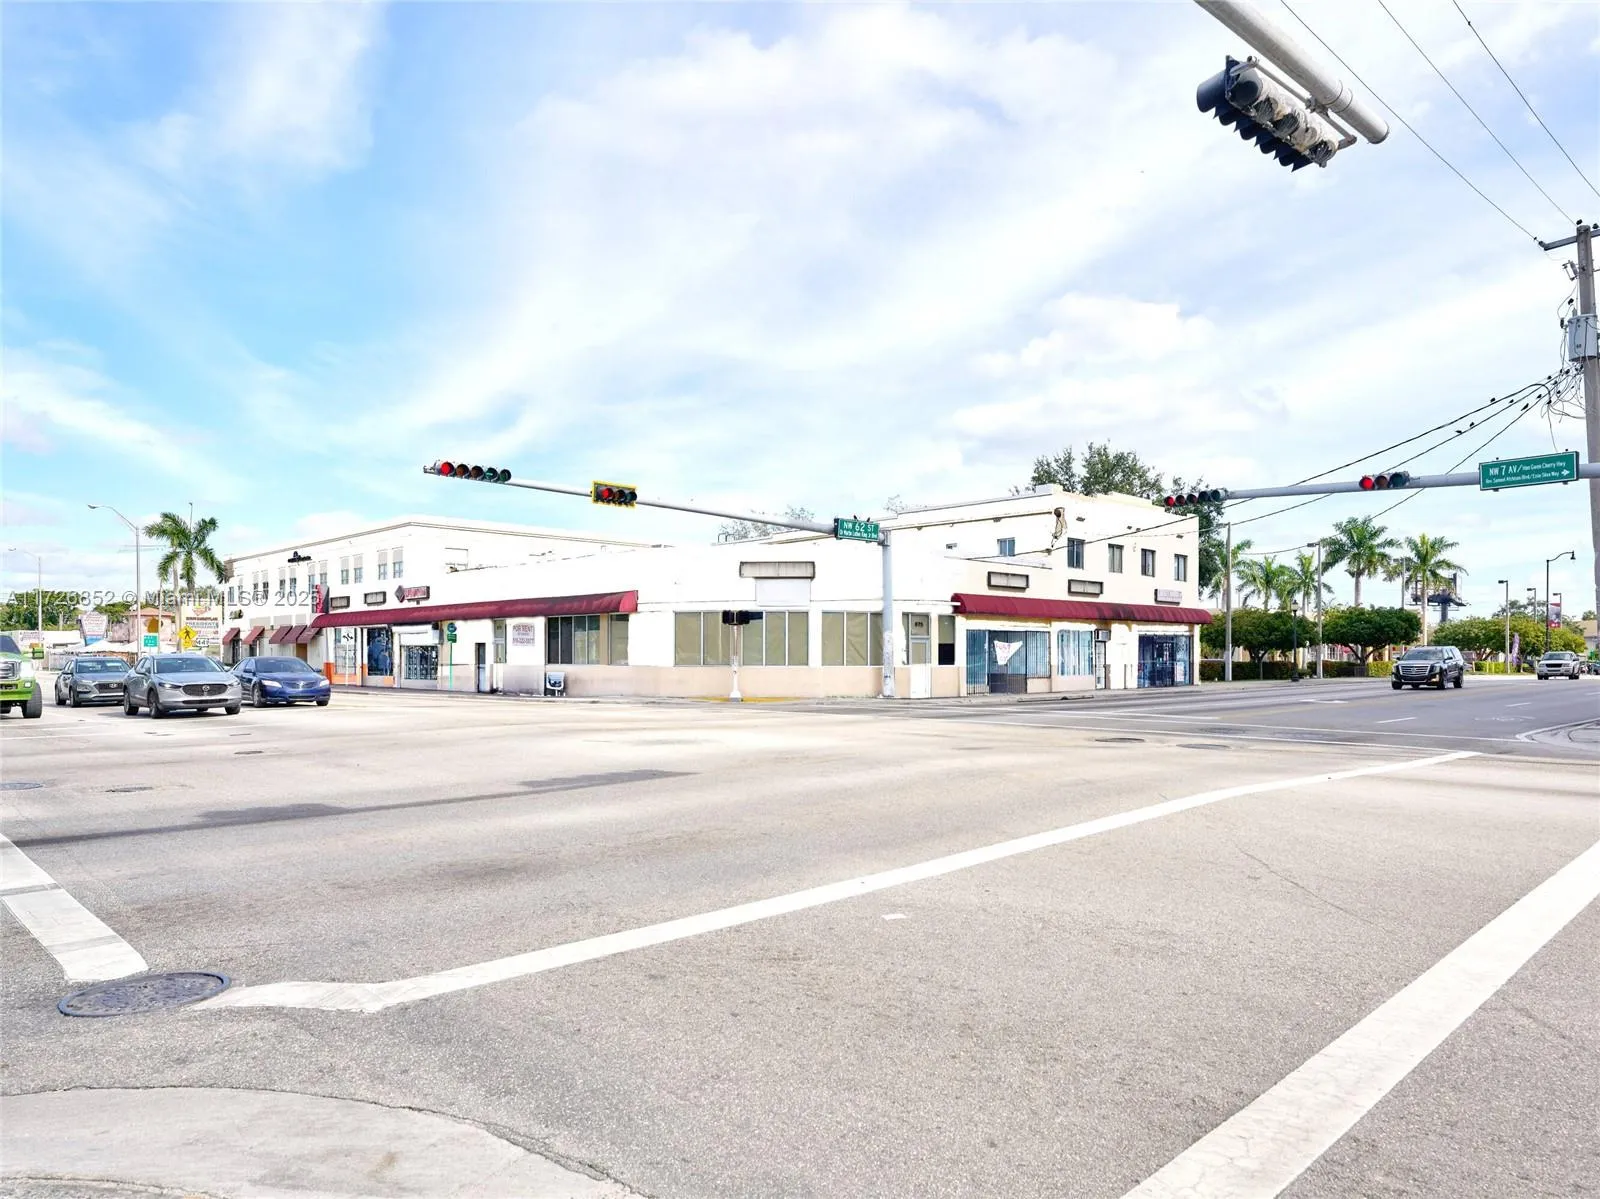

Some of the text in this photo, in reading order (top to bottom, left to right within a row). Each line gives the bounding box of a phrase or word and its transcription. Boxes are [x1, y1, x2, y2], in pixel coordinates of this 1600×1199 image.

[1489, 467, 1500, 477] NW
[1501, 465, 1506, 476] 7
[843, 521, 875, 532] NW 62 ST
